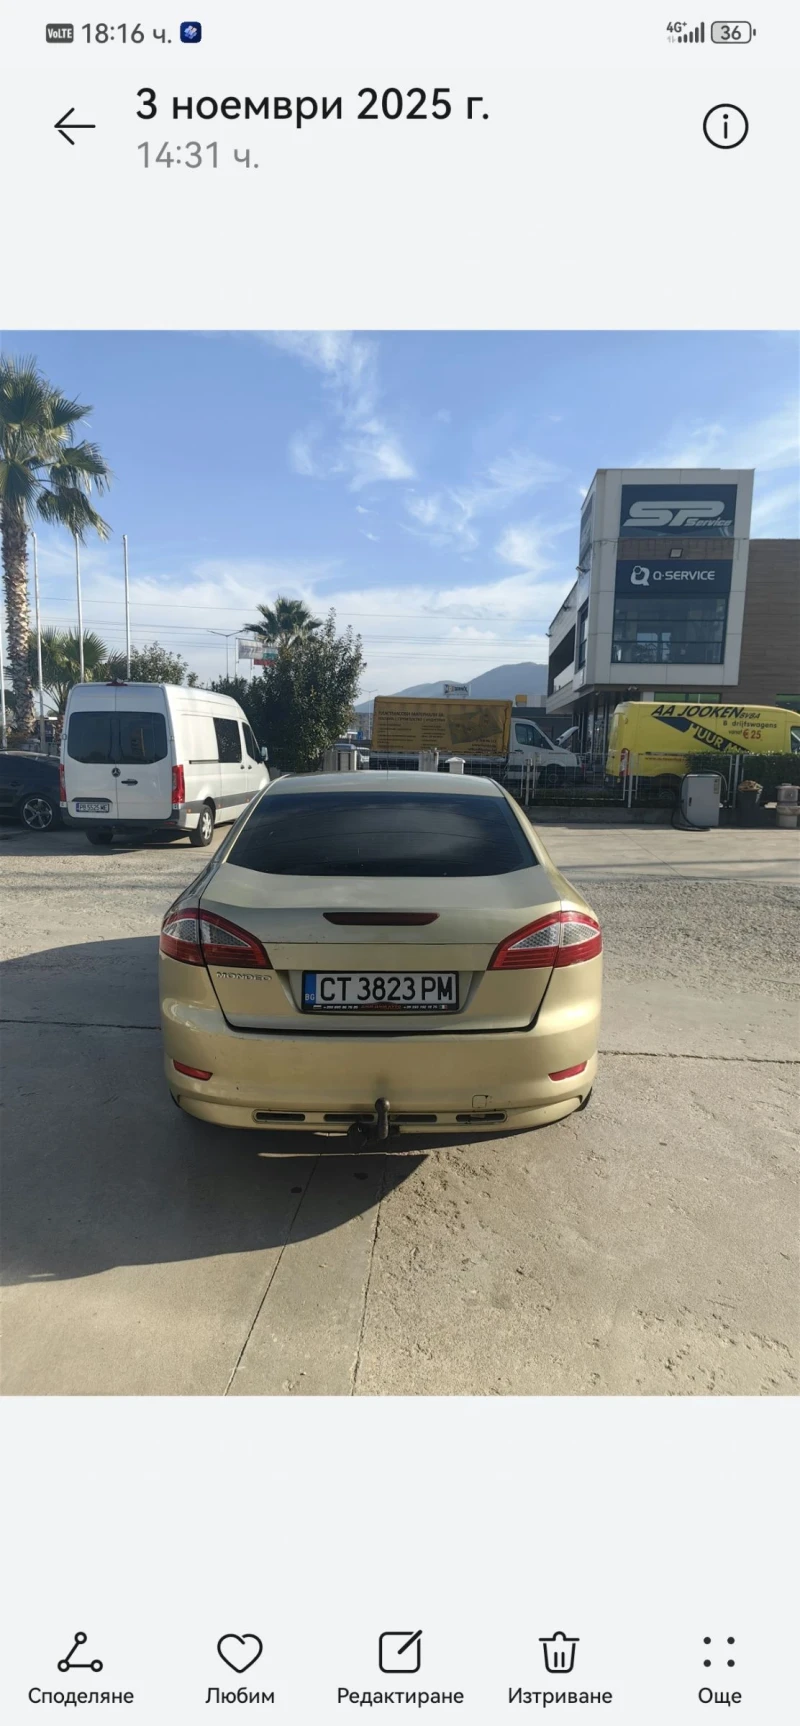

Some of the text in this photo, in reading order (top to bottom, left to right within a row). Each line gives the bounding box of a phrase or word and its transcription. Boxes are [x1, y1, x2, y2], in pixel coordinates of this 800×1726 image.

[47, 28, 72, 39] VoLTE
[82, 23, 172, 43] 18:16 ч.
[720, 25, 742, 41] 36
[136, 88, 489, 129] 3 ноември 2025 г.
[138, 141, 259, 168] 14:31 ч.
[622, 500, 733, 527] SP Service
[651, 704, 761, 720] AA JOOKEN BVBA
[216, 972, 272, 981] MONDEO
[320, 976, 453, 1001] CT 3823 PM
[28, 1687, 134, 1704] Споделяне
[205, 1687, 275, 1704] Любим
[337, 1687, 465, 1708] Редактиране
[508, 1687, 613, 1708] Изтриване
[698, 1687, 743, 1708] Още
